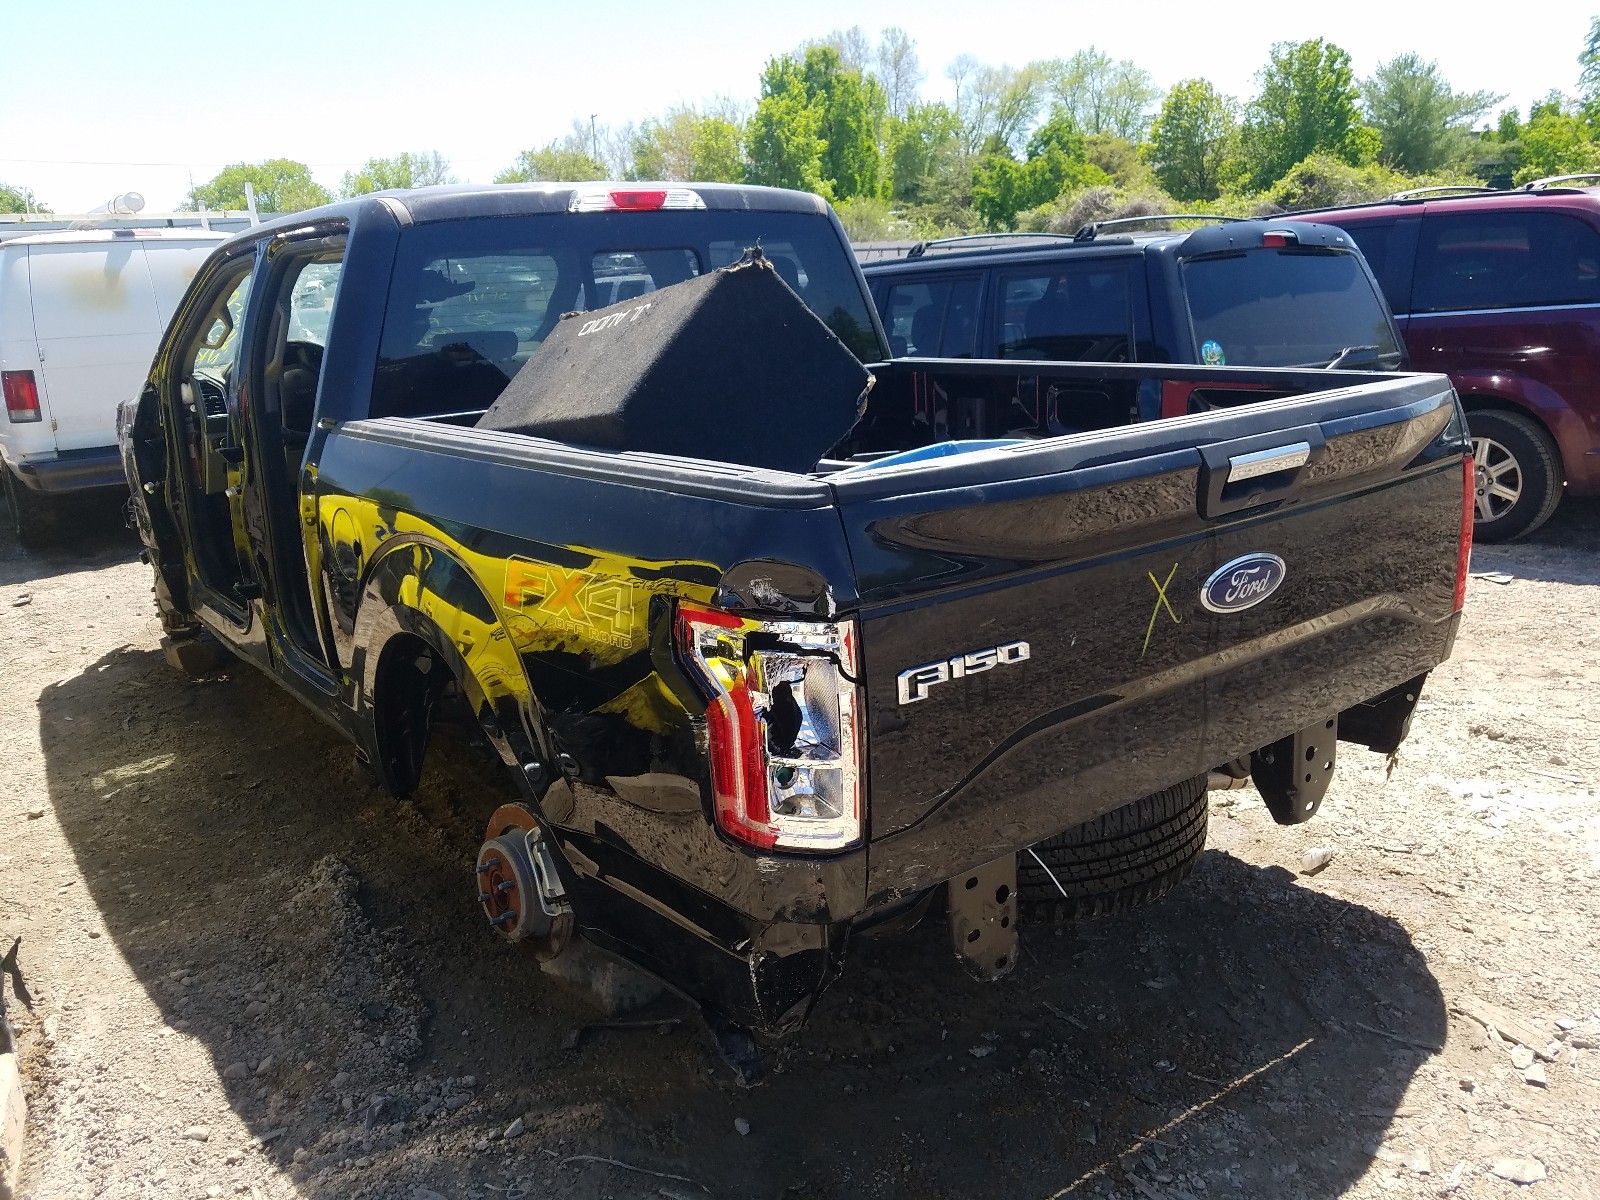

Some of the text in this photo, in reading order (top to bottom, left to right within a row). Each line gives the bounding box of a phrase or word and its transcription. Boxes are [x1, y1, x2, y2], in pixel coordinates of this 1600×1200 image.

[577, 309, 631, 337] AUDIO
[502, 553, 635, 639] FX4
[1224, 566, 1272, 604] Ford
[554, 617, 633, 650] OFF ROAD
[896, 639, 1031, 706] F150
